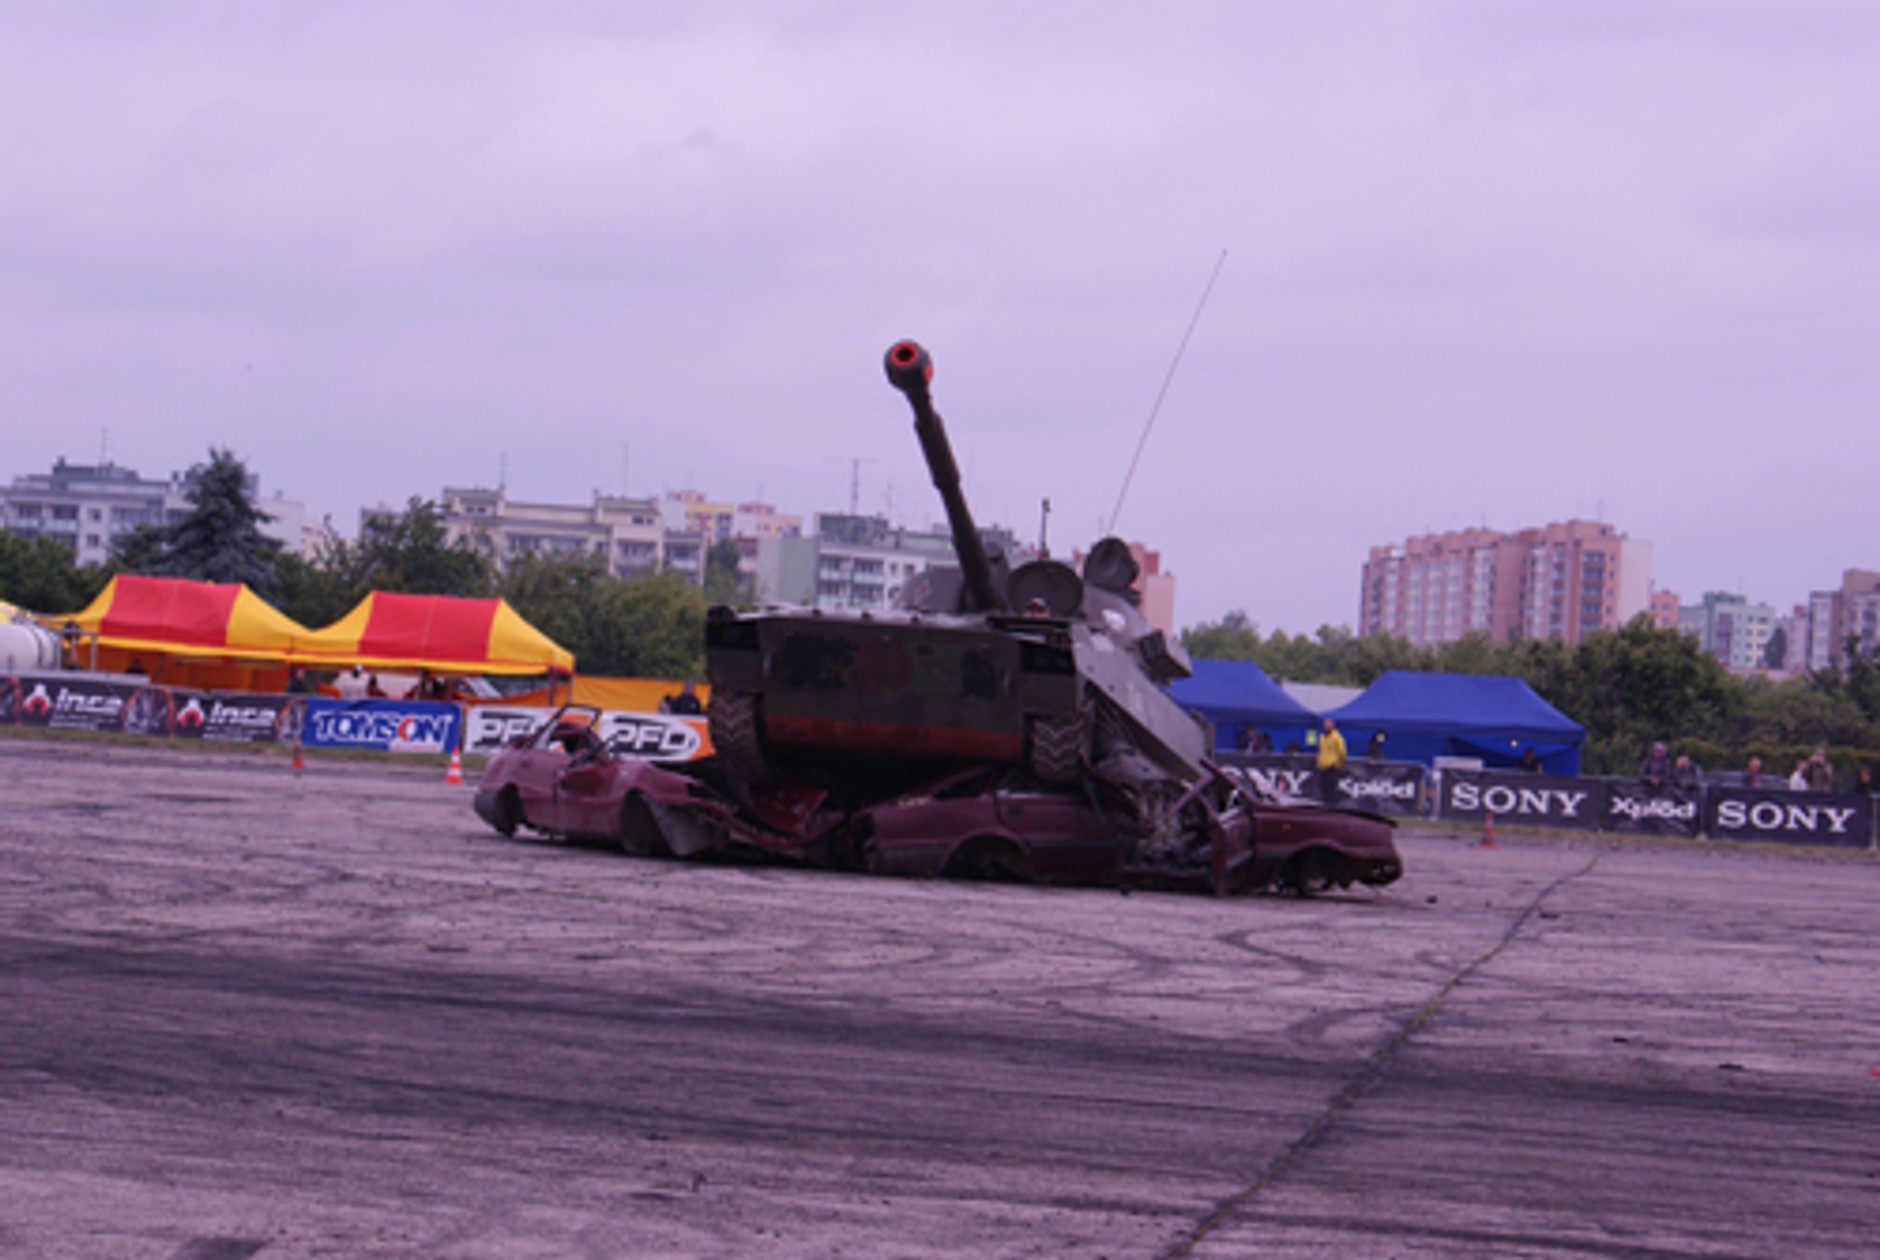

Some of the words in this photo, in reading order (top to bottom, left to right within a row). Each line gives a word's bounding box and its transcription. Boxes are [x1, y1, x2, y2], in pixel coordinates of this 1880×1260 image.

[312, 710, 454, 743] TOMSON
[606, 716, 693, 756] PFD
[1451, 782, 1588, 817] SONY
[1717, 800, 1856, 833] SONY
